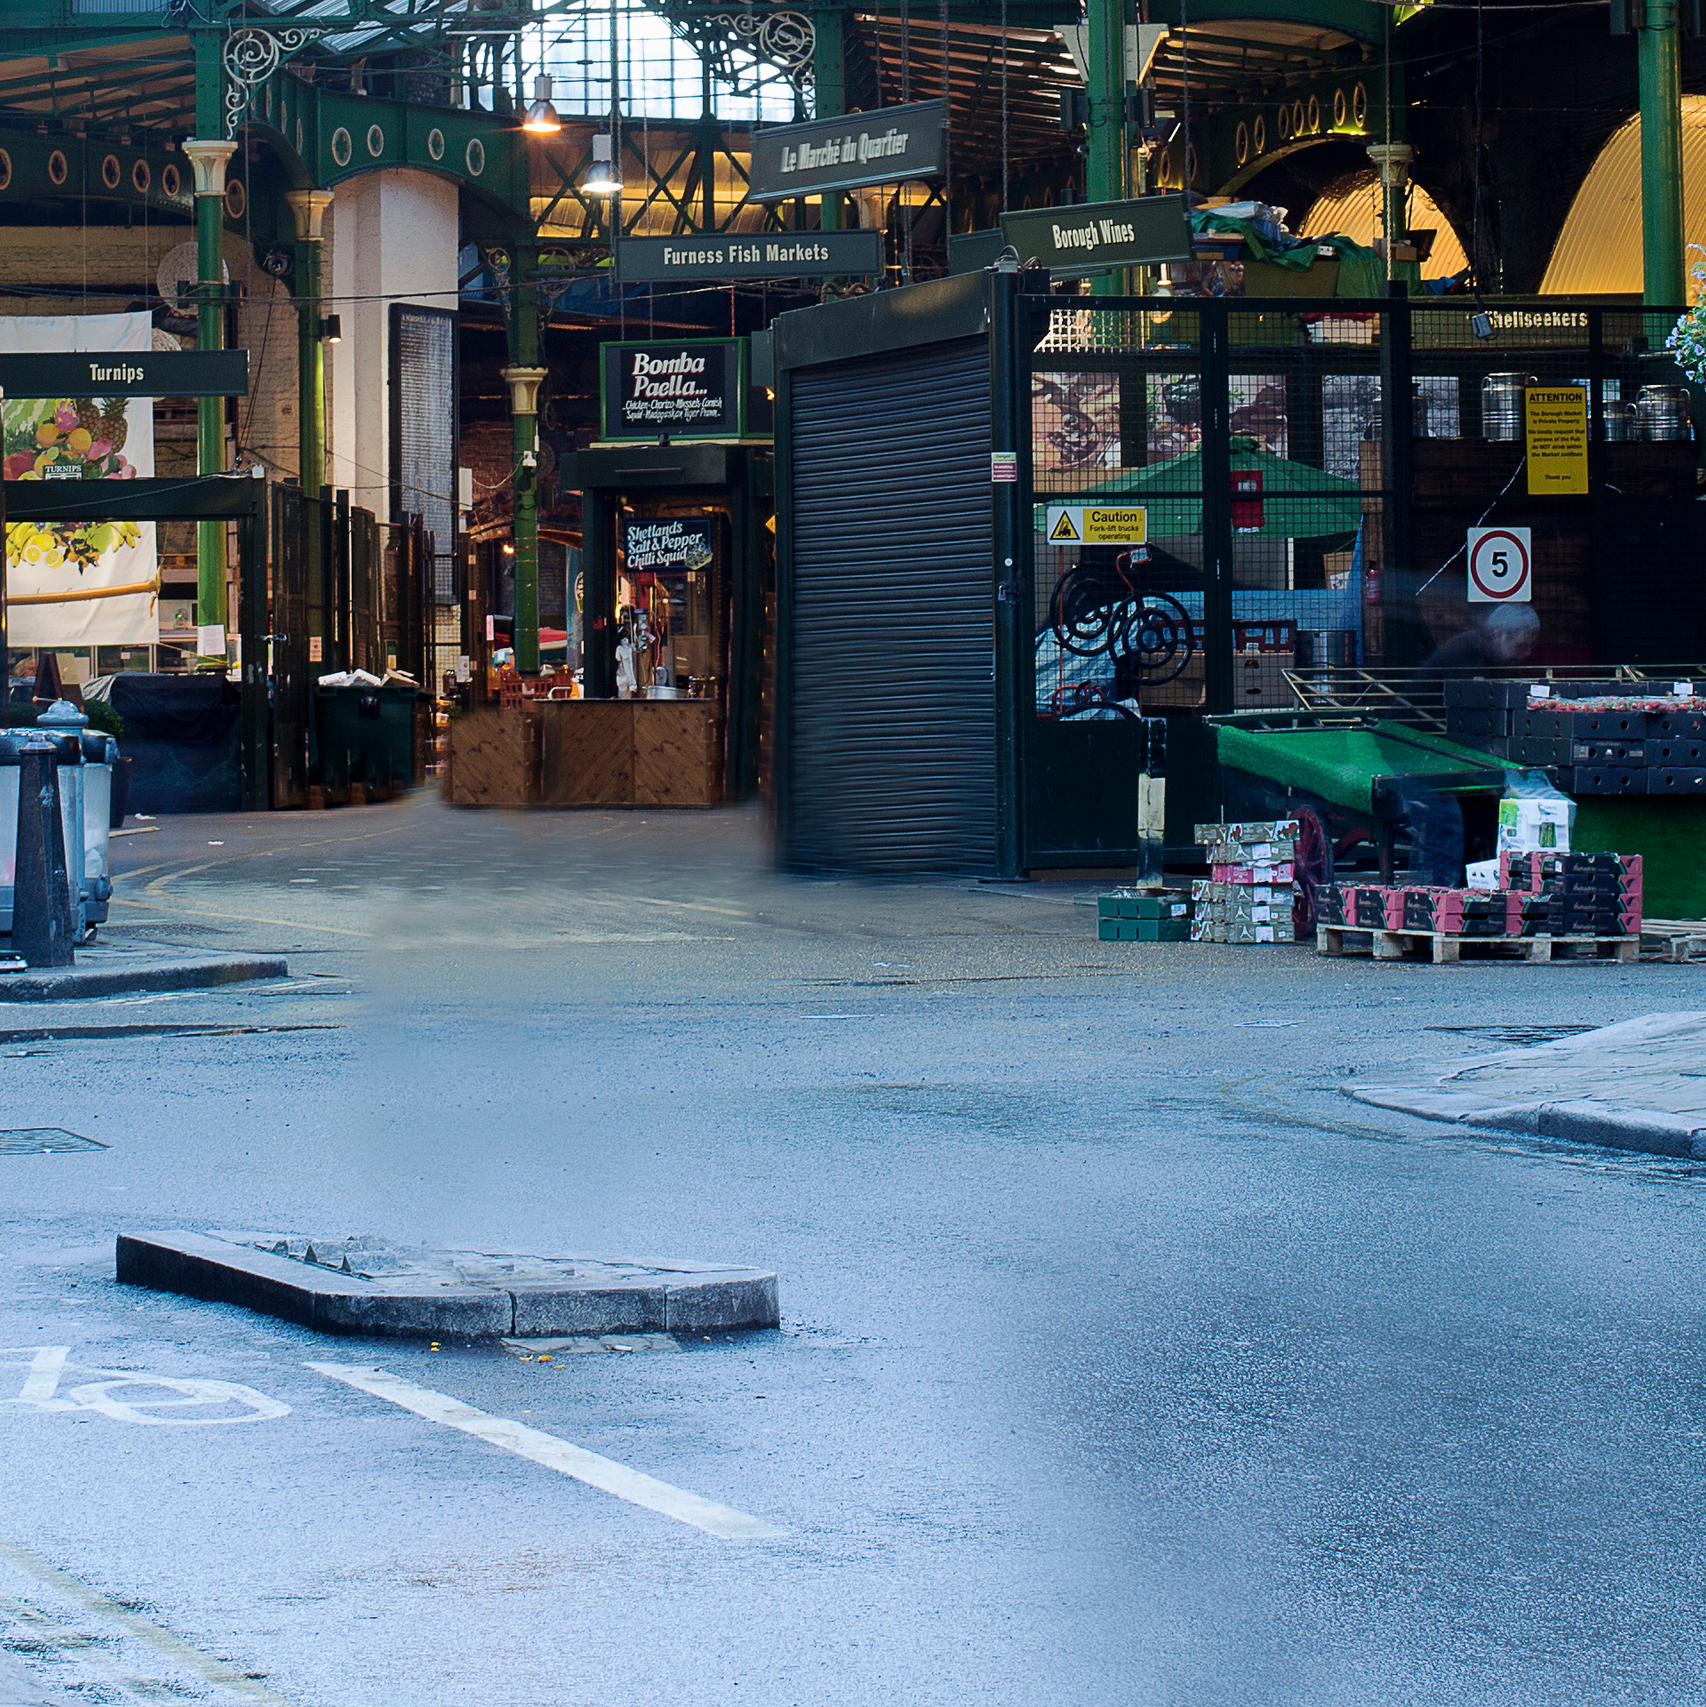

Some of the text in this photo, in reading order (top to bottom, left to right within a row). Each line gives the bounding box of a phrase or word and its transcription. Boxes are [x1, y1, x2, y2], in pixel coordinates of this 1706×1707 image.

[779, 145, 797, 174] Le
[841, 135, 858, 164] du
[858, 128, 909, 165] Quartier
[1052, 219, 1135, 251] Borough Wines
[663, 243, 829, 265] Furness Fish Markets
[89, 363, 145, 384] Turnips
[631, 351, 706, 376] Bomba
[633, 374, 708, 398] Paella...
[1529, 393, 1583, 403] ATTENTION
[45, 465, 82, 473] TURNIPS
[1091, 510, 1137, 522] Caution
[628, 520, 683, 542] Shetlands
[1098, 533, 1131, 541] operating
[628, 533, 703, 555] Salt & Pepper
[627, 546, 688, 570] Chilli Squid
[1492, 551, 1509, 578] 5
